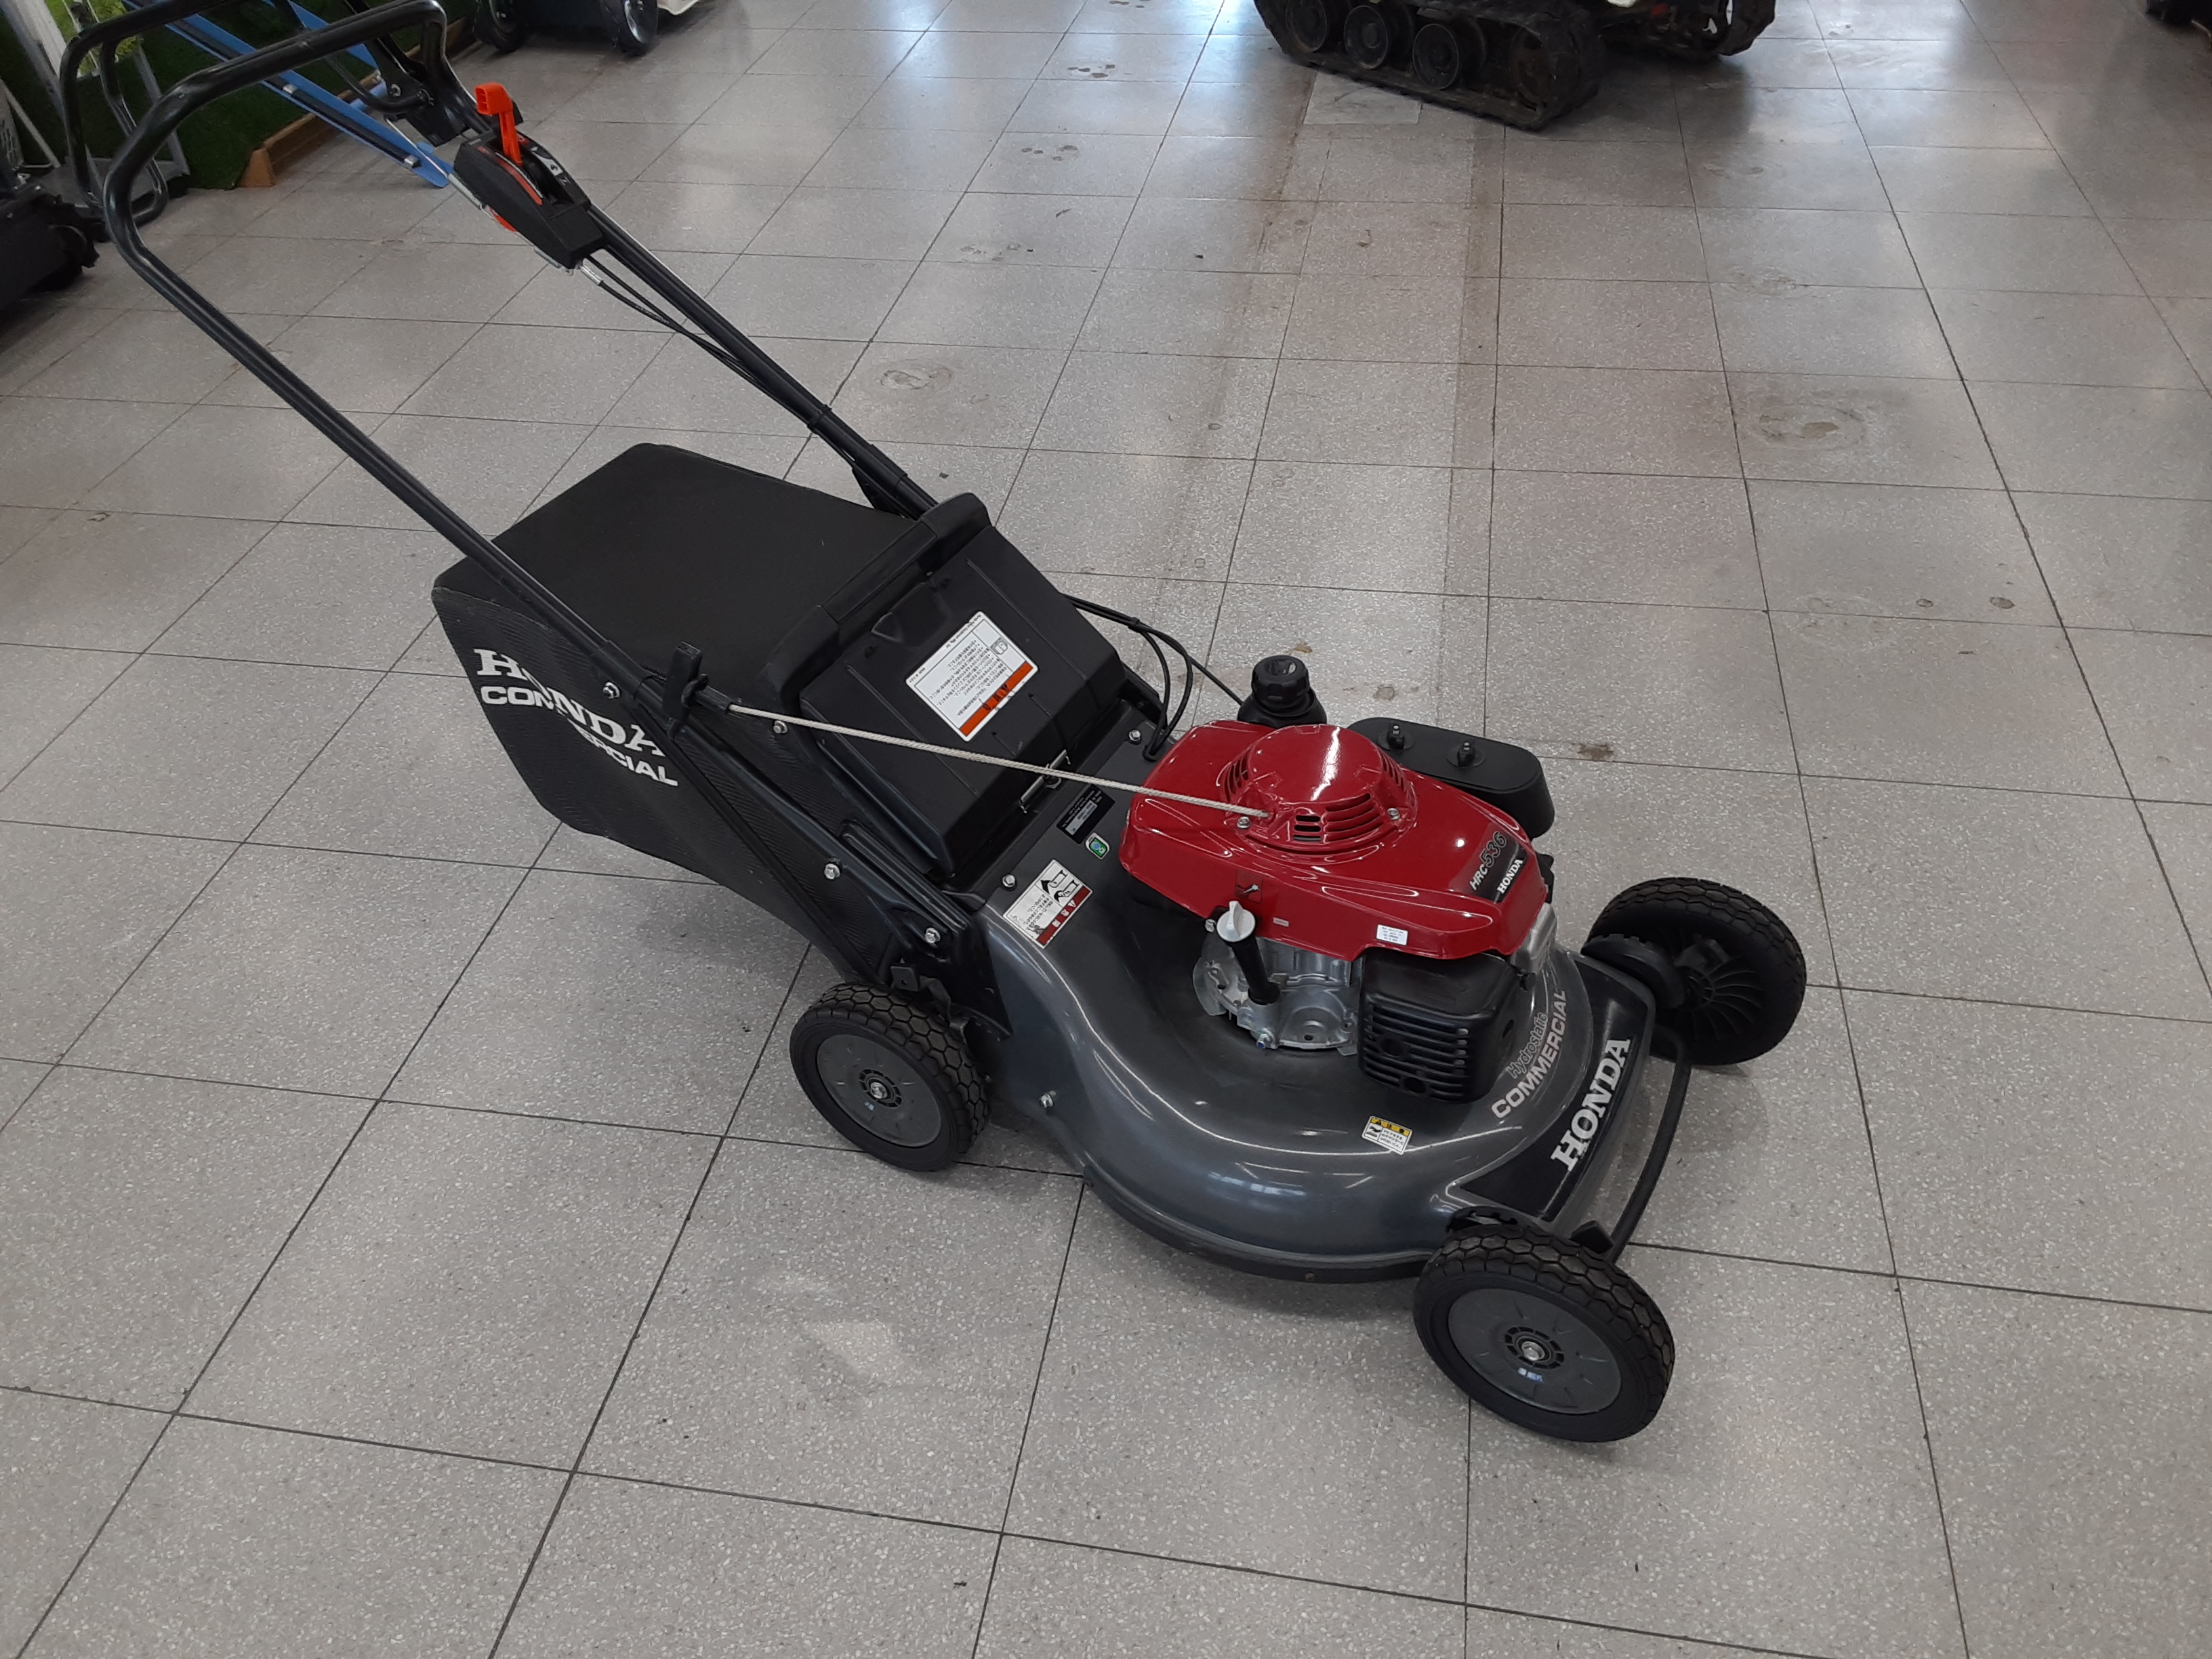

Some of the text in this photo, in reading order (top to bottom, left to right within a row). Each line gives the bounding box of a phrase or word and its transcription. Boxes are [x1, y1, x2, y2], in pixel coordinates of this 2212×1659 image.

[1497, 859, 1523, 895] HONDA
[1491, 989, 1567, 1118] COMMERCIAL
[1507, 1012, 1549, 1079] Hydrostatic
[1551, 1038, 1631, 1172] HONDA
